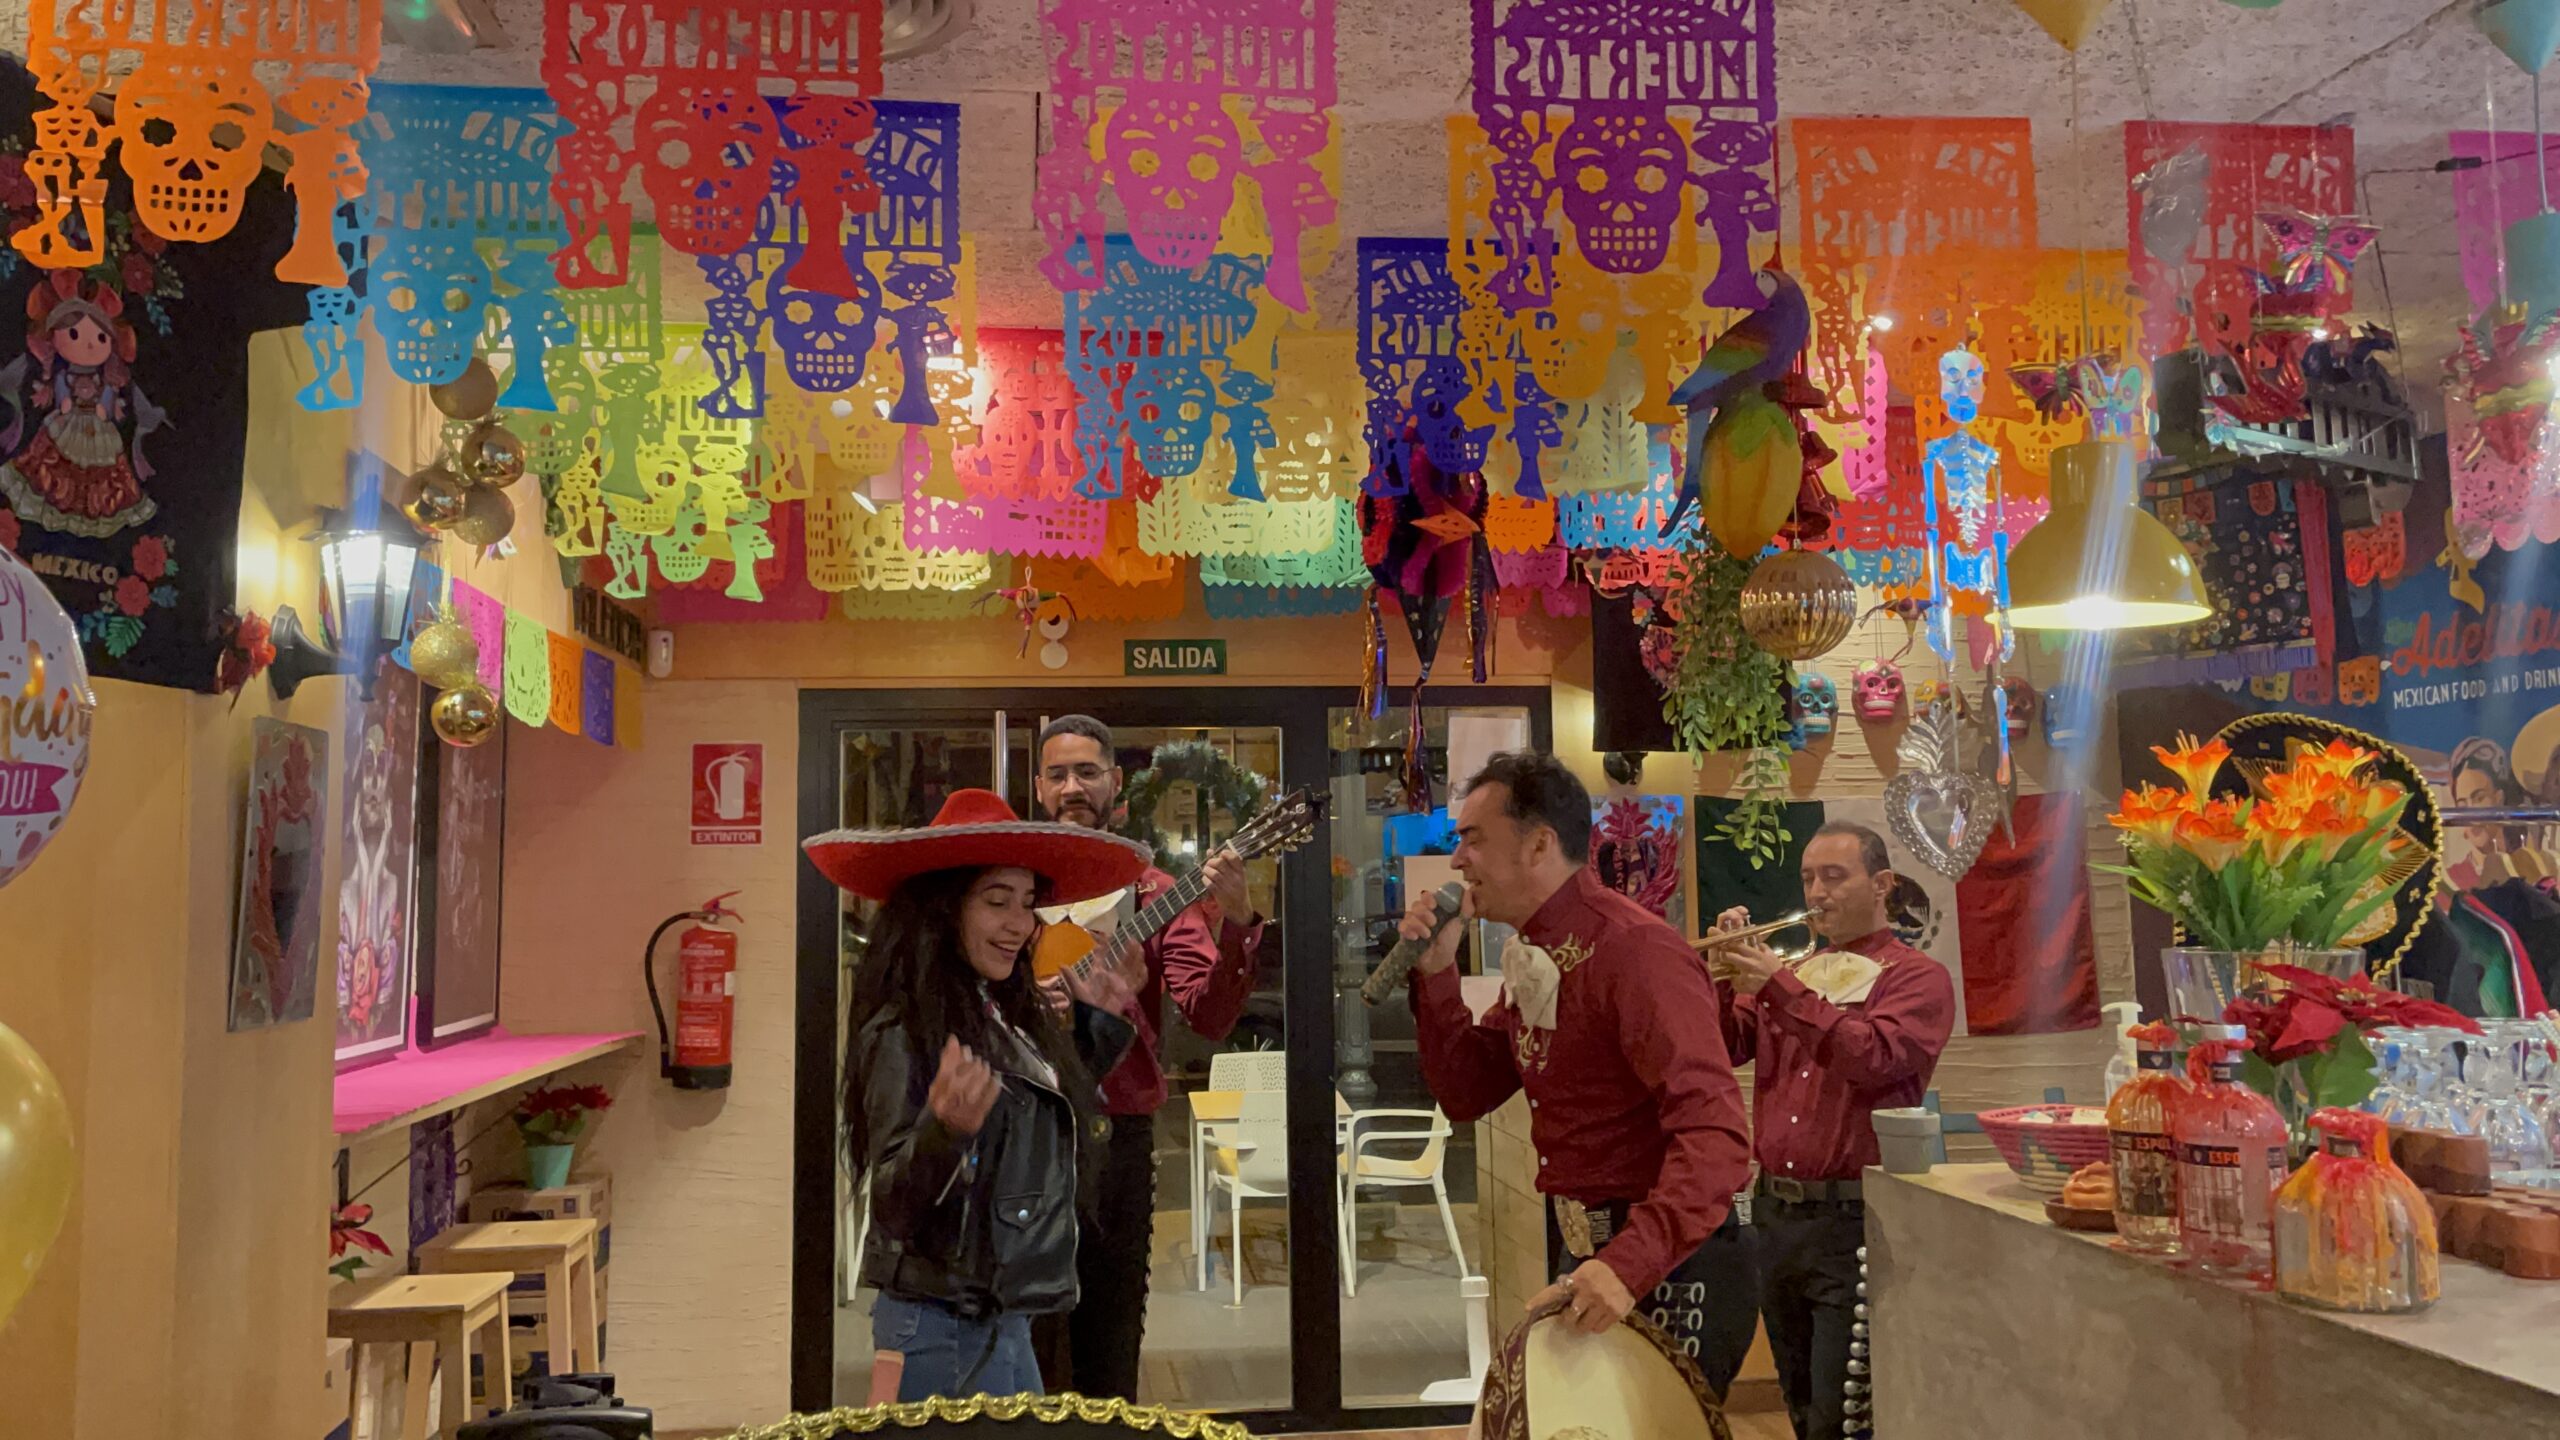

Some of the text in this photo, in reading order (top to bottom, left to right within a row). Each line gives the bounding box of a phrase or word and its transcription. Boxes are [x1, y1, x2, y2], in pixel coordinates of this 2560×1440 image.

[32, 552, 118, 585] MEXICO
[1133, 647, 1217, 669] SALIDA
[2393, 666, 2560, 709] MEXICAN FOOD AND DRIN
[695, 831, 757, 843] EXTINTOR
